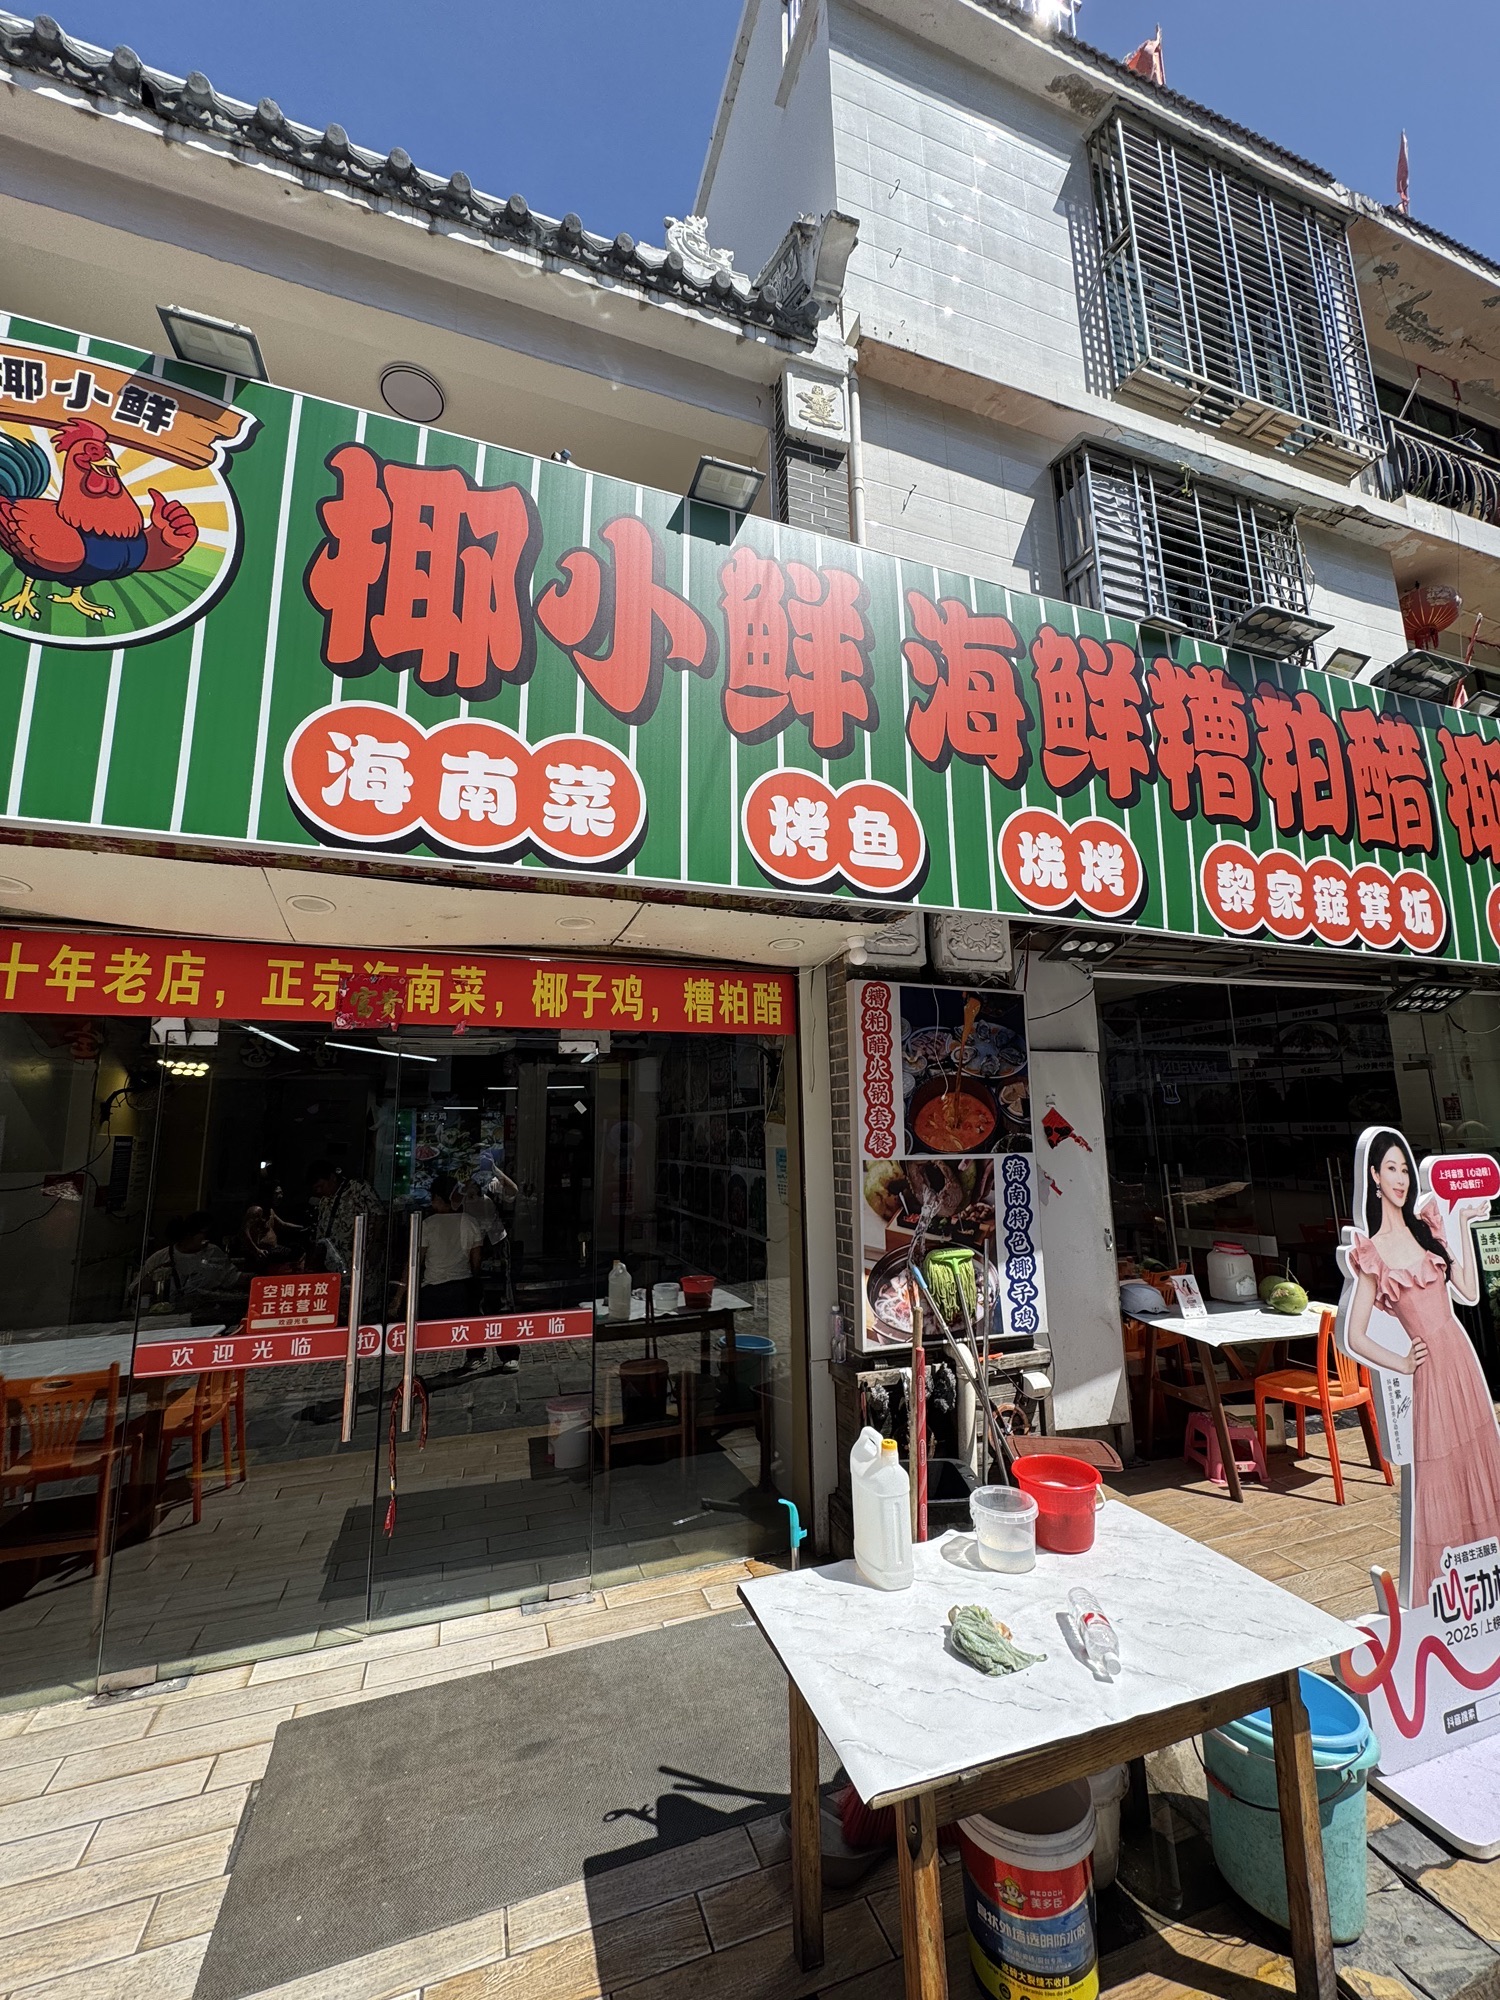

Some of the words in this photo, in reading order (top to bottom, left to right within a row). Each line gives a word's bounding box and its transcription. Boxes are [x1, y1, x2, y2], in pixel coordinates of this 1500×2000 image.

[307, 444, 873, 756] 椰小鲜
[321, 730, 616, 838] 海南菜
[768, 793, 904, 872] 烤鱼
[1017, 831, 1126, 899] 烧烤
[1216, 860, 1435, 936] 黎家簸箕饭
[865, 987, 893, 1155] 糟粕醋火锅套餐
[1008, 1160, 1036, 1331] 海南特色椰子鸡
[260, 1298, 328, 1316] 正在营业
[262, 1281, 329, 1299] 空调开放
[278, 1317, 309, 1326] 欢迎光临
[357, 1332, 376, 1351] 拉
[451, 1316, 566, 1344] 欢迎光临
[170, 1336, 313, 1368] 欢迎光临
[1453, 1543, 1498, 1566] 抖音生活服务
[1433, 1565, 1500, 1623] 心动
[1446, 1708, 1476, 1728] 抖音搜索
